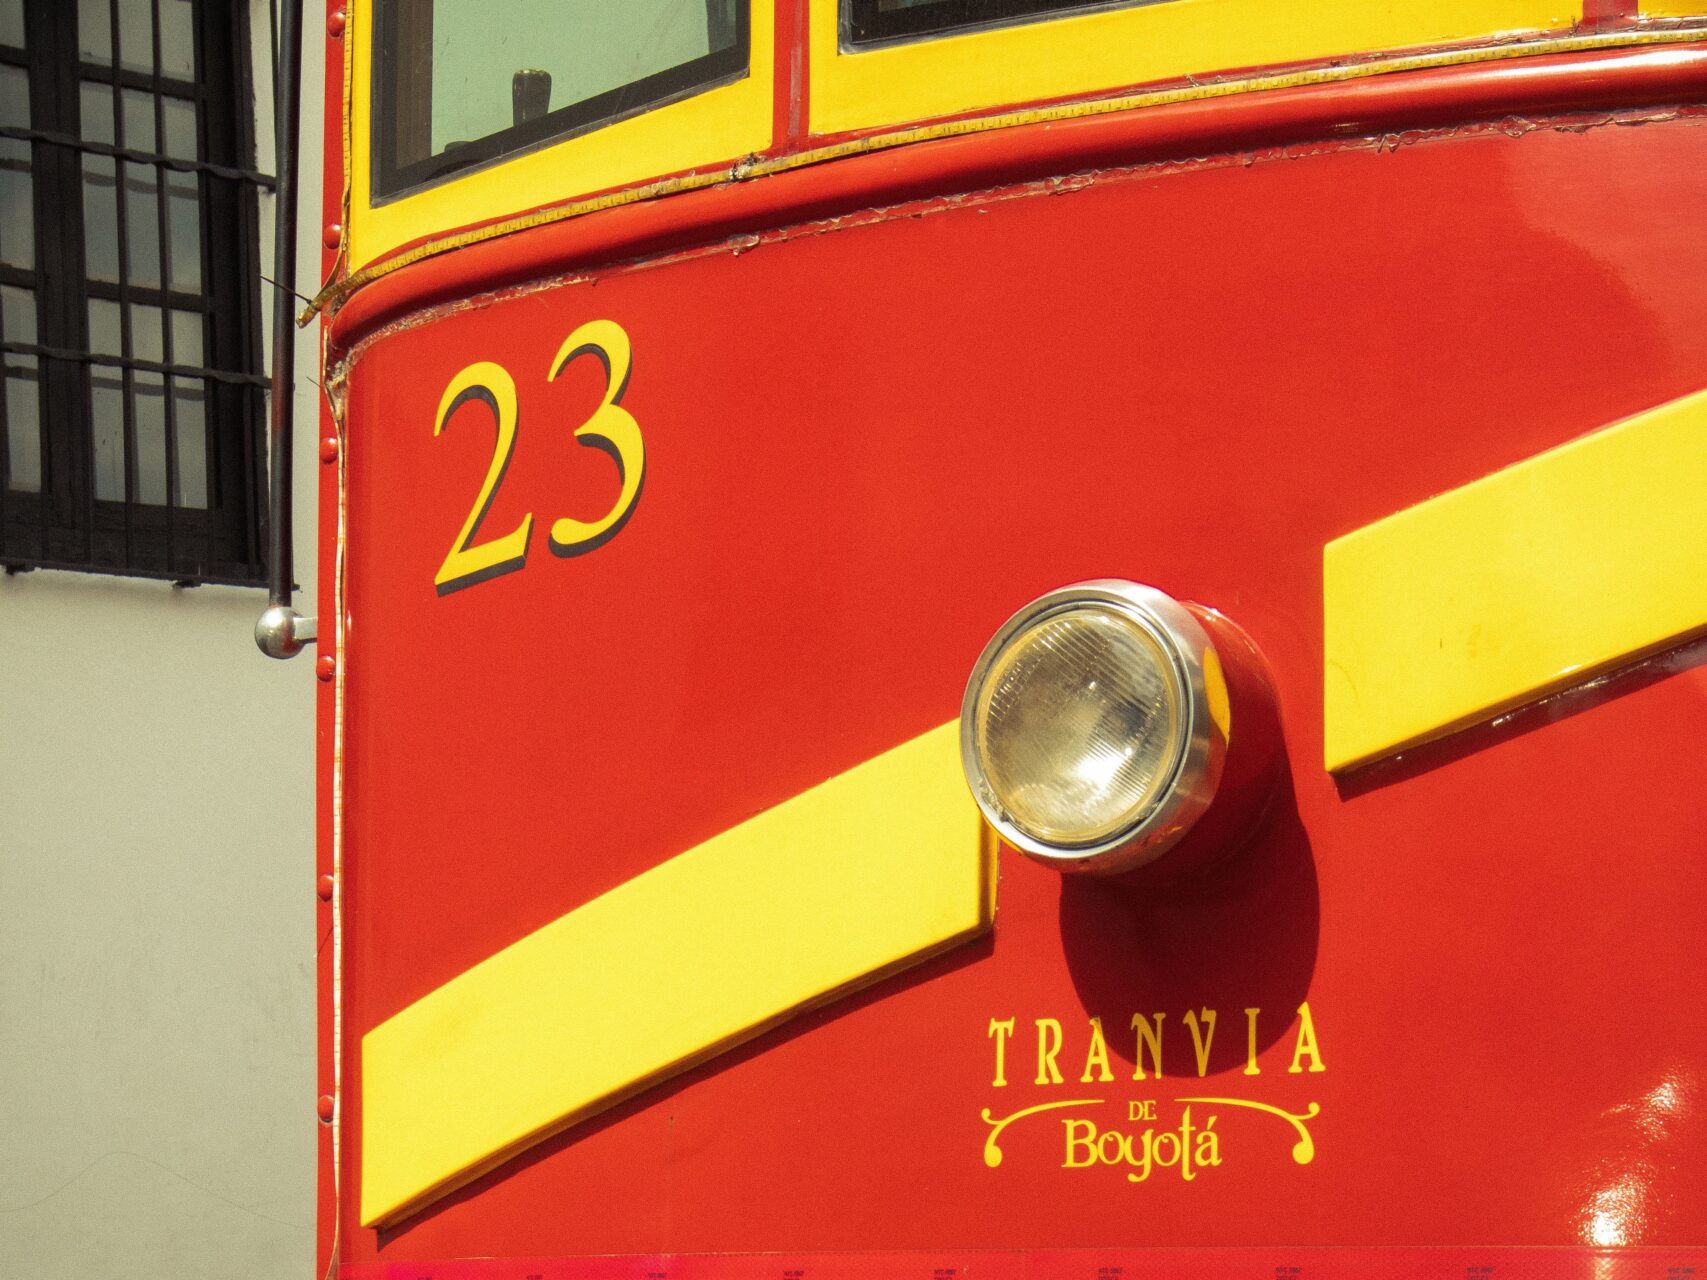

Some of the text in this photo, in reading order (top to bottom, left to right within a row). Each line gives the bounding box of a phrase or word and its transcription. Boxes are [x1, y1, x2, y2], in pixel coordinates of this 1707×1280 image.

[433, 318, 647, 598] 23
[987, 1001, 1326, 1088] TRANVIA
[1128, 1099, 1158, 1121] DE
